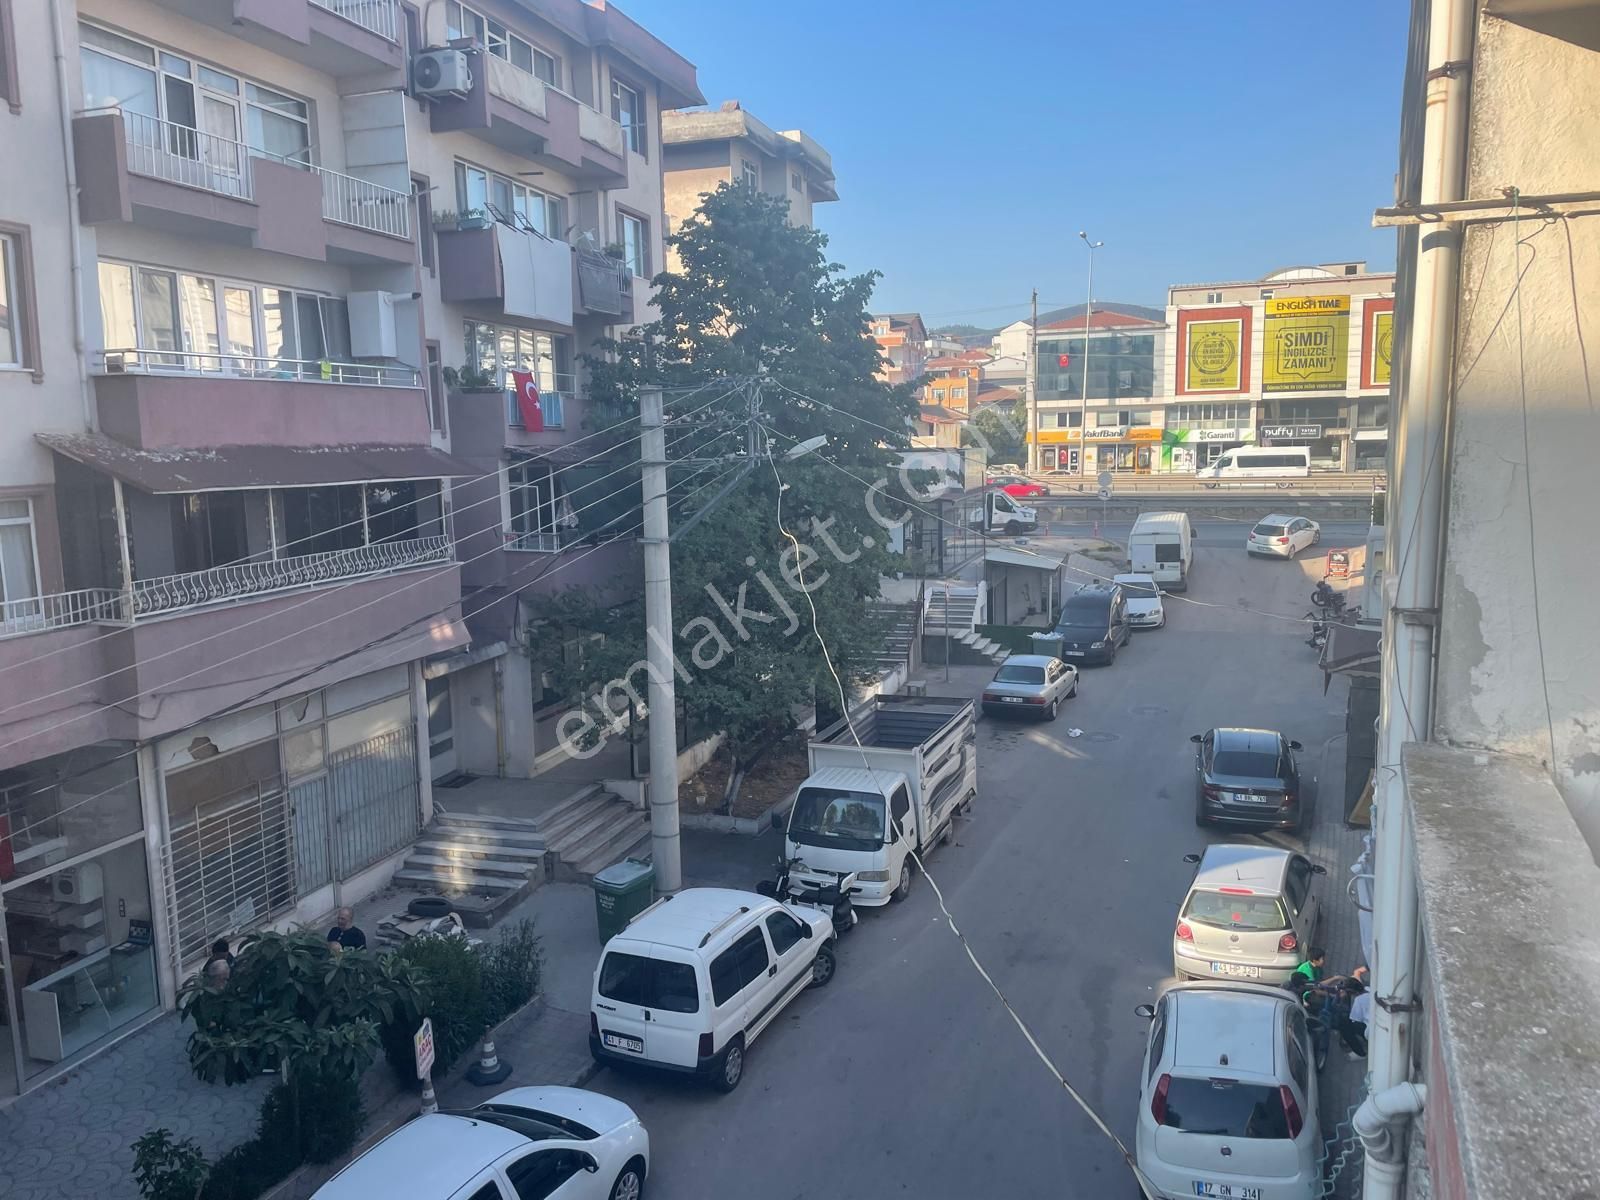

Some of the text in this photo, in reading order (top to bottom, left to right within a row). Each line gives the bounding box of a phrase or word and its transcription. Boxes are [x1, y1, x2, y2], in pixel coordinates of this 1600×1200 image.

[1318, 299, 1342, 309] TIME
[1207, 431, 1235, 439] Garanti
[1264, 427, 1293, 438] puffy
[1205, 1182, 1213, 1192] 17
